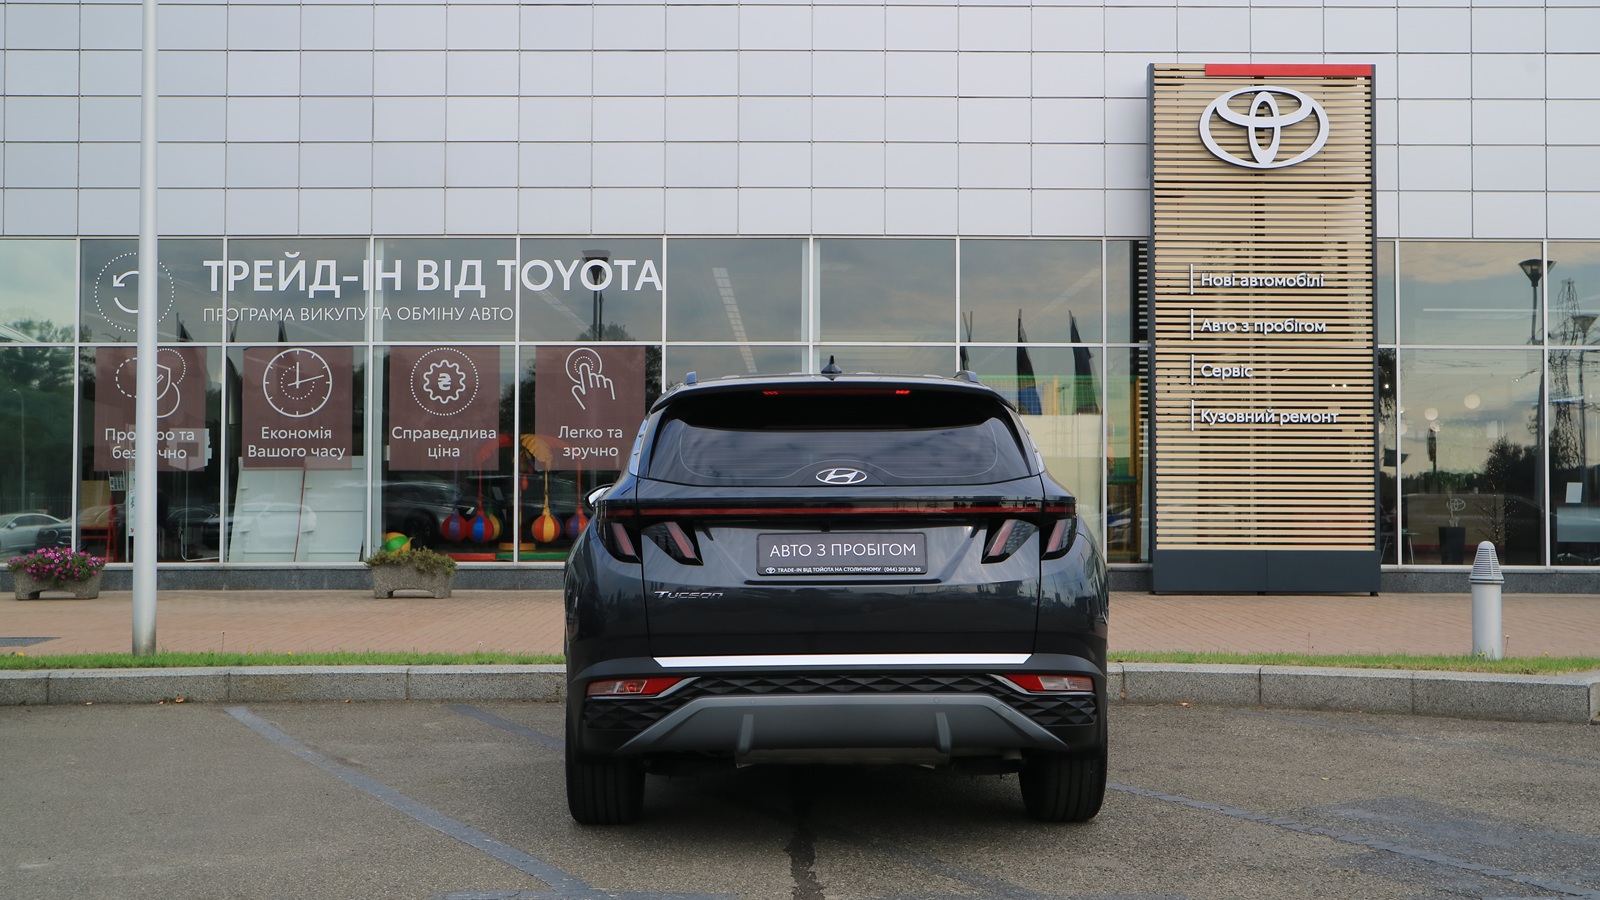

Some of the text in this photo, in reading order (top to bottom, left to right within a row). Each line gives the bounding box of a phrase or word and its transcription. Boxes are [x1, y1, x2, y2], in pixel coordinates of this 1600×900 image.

[203, 252, 663, 298] ТРЕЙД-ІН ВІД TOYOTA
[1201, 273, 1325, 287] Нові автомобілі
[203, 307, 514, 321] ПРОГРАМА ВИКУПУ ТА ОБМІНУ АВТО
[1201, 318, 1327, 336] Авто з пробігом
[1201, 363, 1253, 380] Сервіс
[1201, 408, 1339, 426] Кузовний ремонт
[105, 428, 195, 444] Проро та
[261, 426, 332, 439] Економія
[391, 426, 497, 442] Справедлива
[558, 426, 623, 439] Легко та
[112, 445, 187, 459] безчно
[248, 445, 346, 460] Вашого часу
[428, 445, 460, 458] ціна
[562, 446, 619, 460] зручно
[769, 544, 812, 557] АВТО
[831, 543, 916, 557] ПРОБІГОМ
